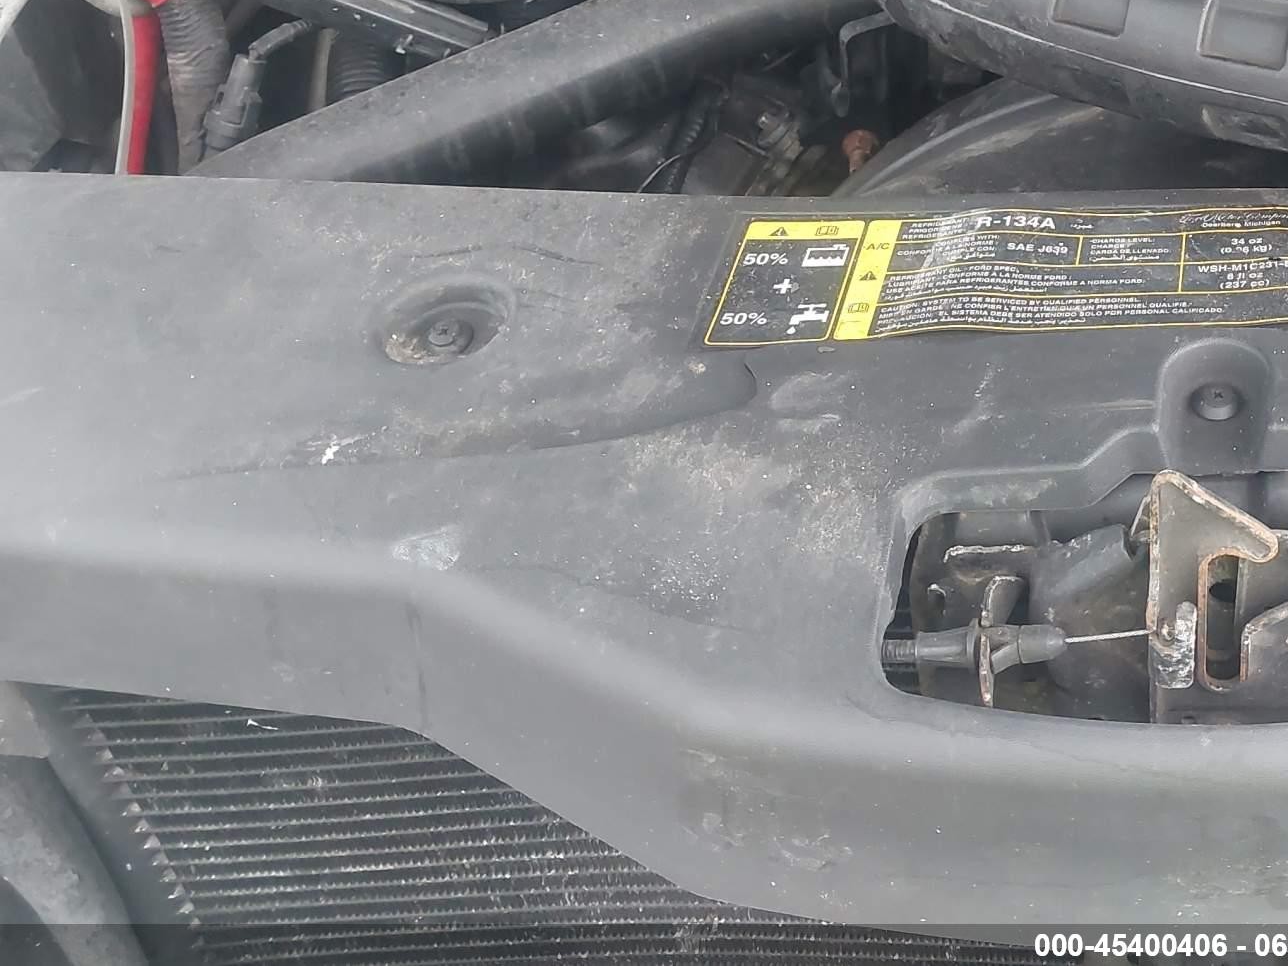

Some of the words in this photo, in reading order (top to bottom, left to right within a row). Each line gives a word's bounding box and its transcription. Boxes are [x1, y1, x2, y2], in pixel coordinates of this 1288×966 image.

[974, 215, 1056, 230] R-134A
[1231, 237, 1246, 245] 34
[866, 242, 890, 251] A/C
[1007, 242, 1035, 252] SAE
[1037, 244, 1069, 255] J639
[1253, 244, 1273, 253] kg)
[743, 252, 789, 265] 50%
[948, 265, 963, 274] OIL
[967, 265, 993, 273] FORD
[942, 272, 989, 280] CONFORME
[1012, 273, 1043, 281] NORME
[1248, 272, 1264, 280] oz
[1219, 280, 1247, 290] (237
[1250, 278, 1271, 288] cc)
[886, 286, 903, 295] USE
[985, 296, 1028, 305] SERVICED
[964, 302, 1004, 310] CONFIER
[1095, 302, 1148, 310] PERSONNEL
[719, 312, 767, 326] 50%
[990, 310, 1015, 318] DEBE
[1035, 311, 1079, 319] ATENDIDO
